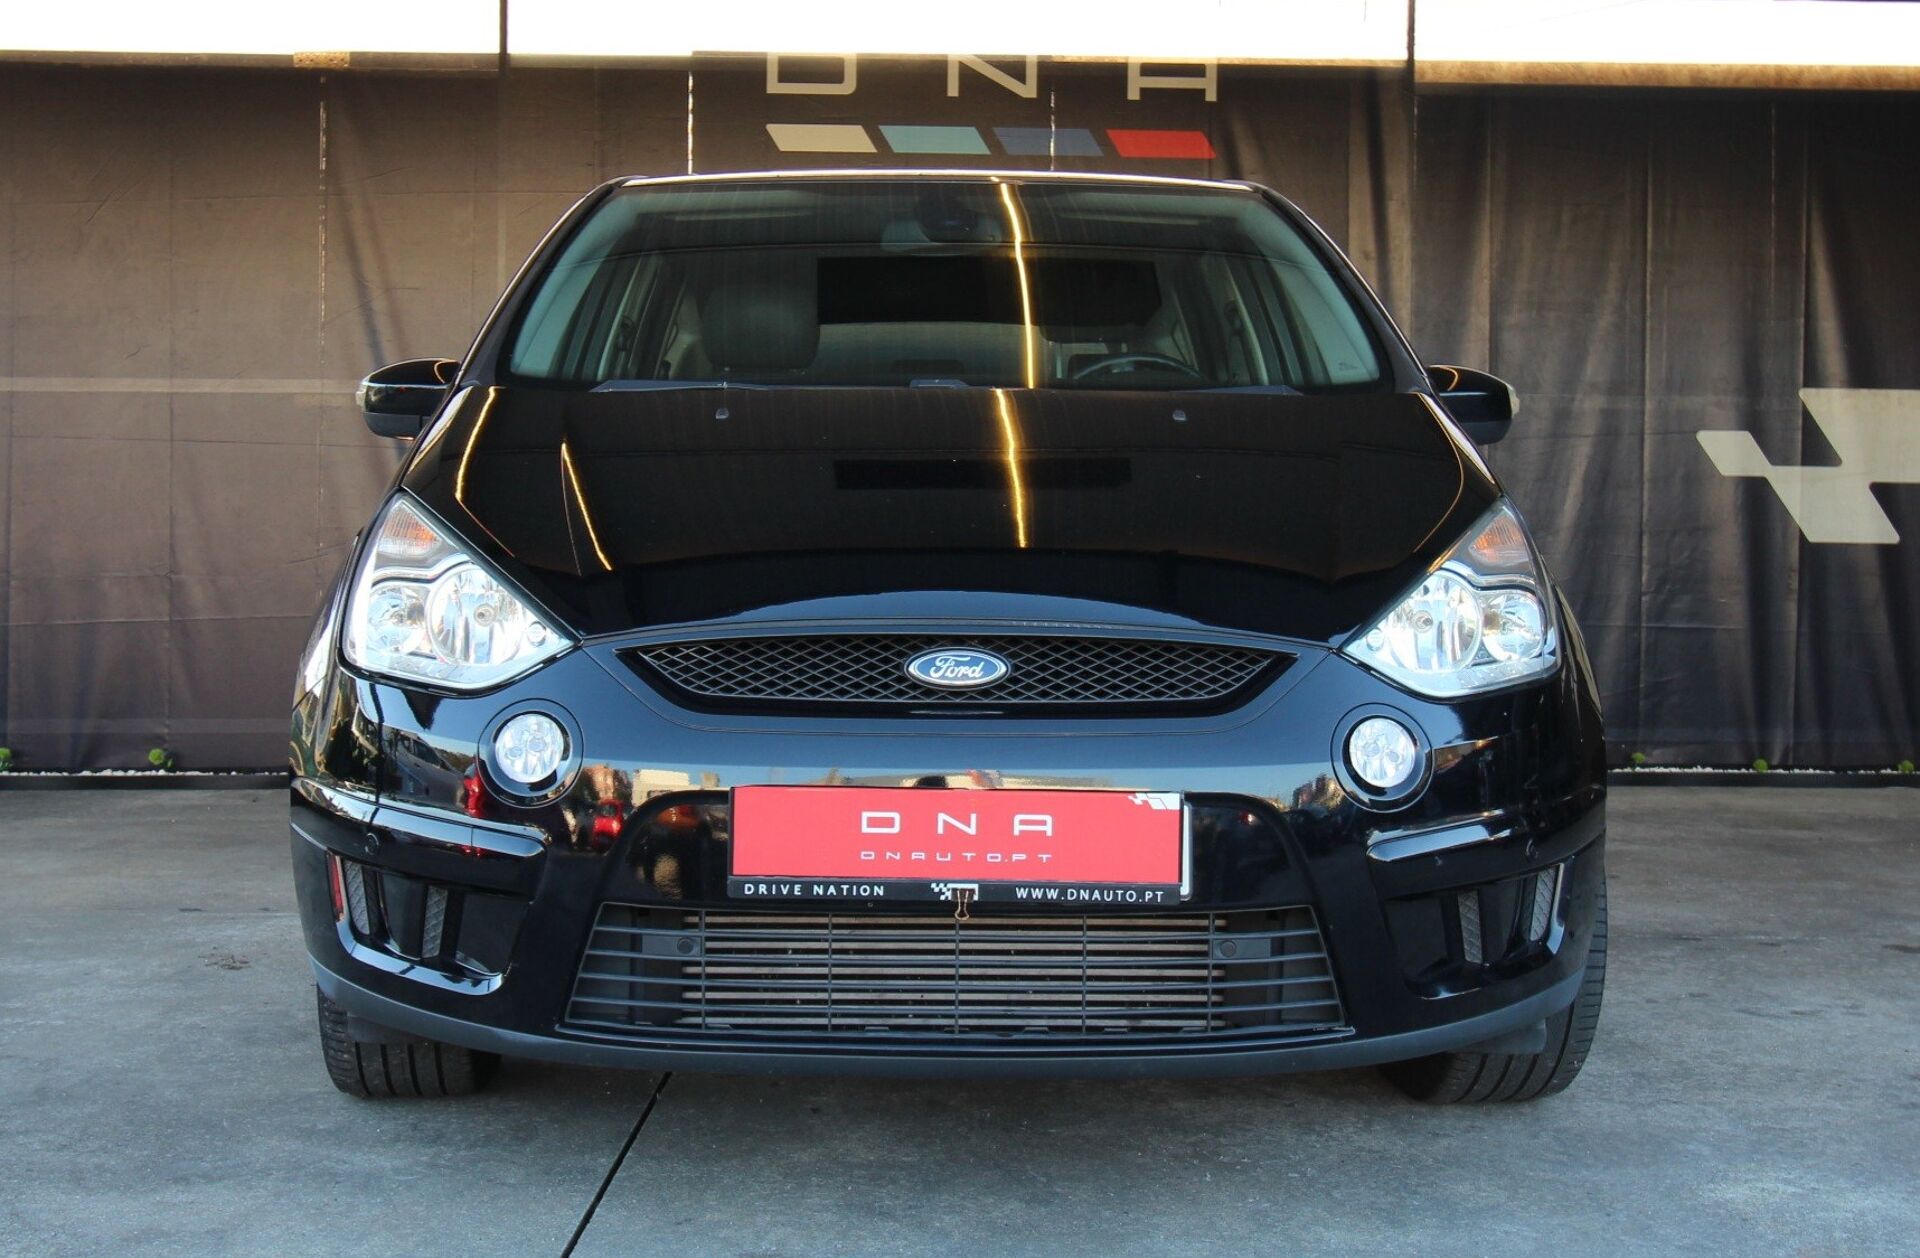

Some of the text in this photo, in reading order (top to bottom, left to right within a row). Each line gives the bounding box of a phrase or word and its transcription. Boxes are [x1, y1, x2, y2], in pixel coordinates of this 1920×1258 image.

[929, 655, 985, 678] Ford
[861, 811, 1053, 836] DNA
[860, 851, 1053, 863] DNAUTO.PT
[744, 883, 885, 896] DRIVE NATION
[1015, 887, 1164, 903] WWW.DNAUTO.PT
